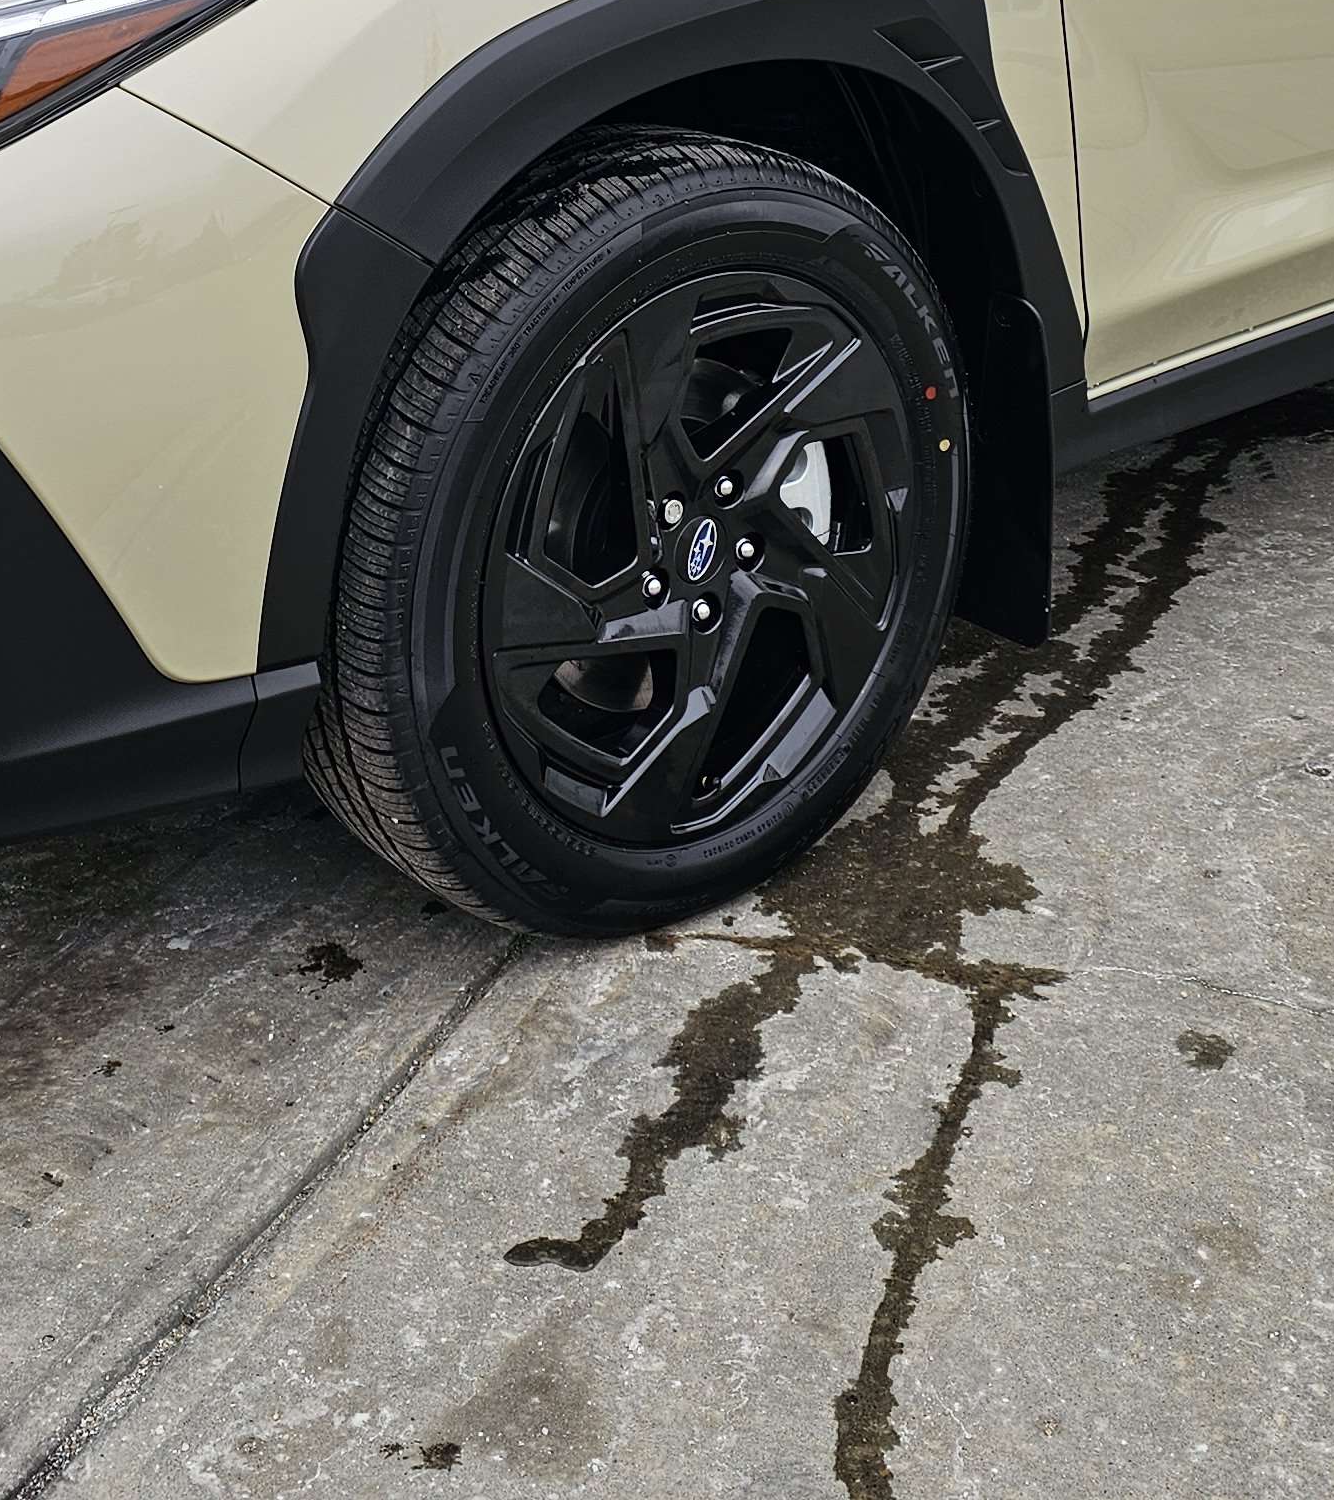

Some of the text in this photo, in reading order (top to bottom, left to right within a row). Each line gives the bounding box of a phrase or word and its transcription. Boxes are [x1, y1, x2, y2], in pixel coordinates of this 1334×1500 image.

[523, 305, 551, 337] TRACTION
[561, 253, 604, 292] TEMPERATURE
[861, 242, 960, 399] FALKEN
